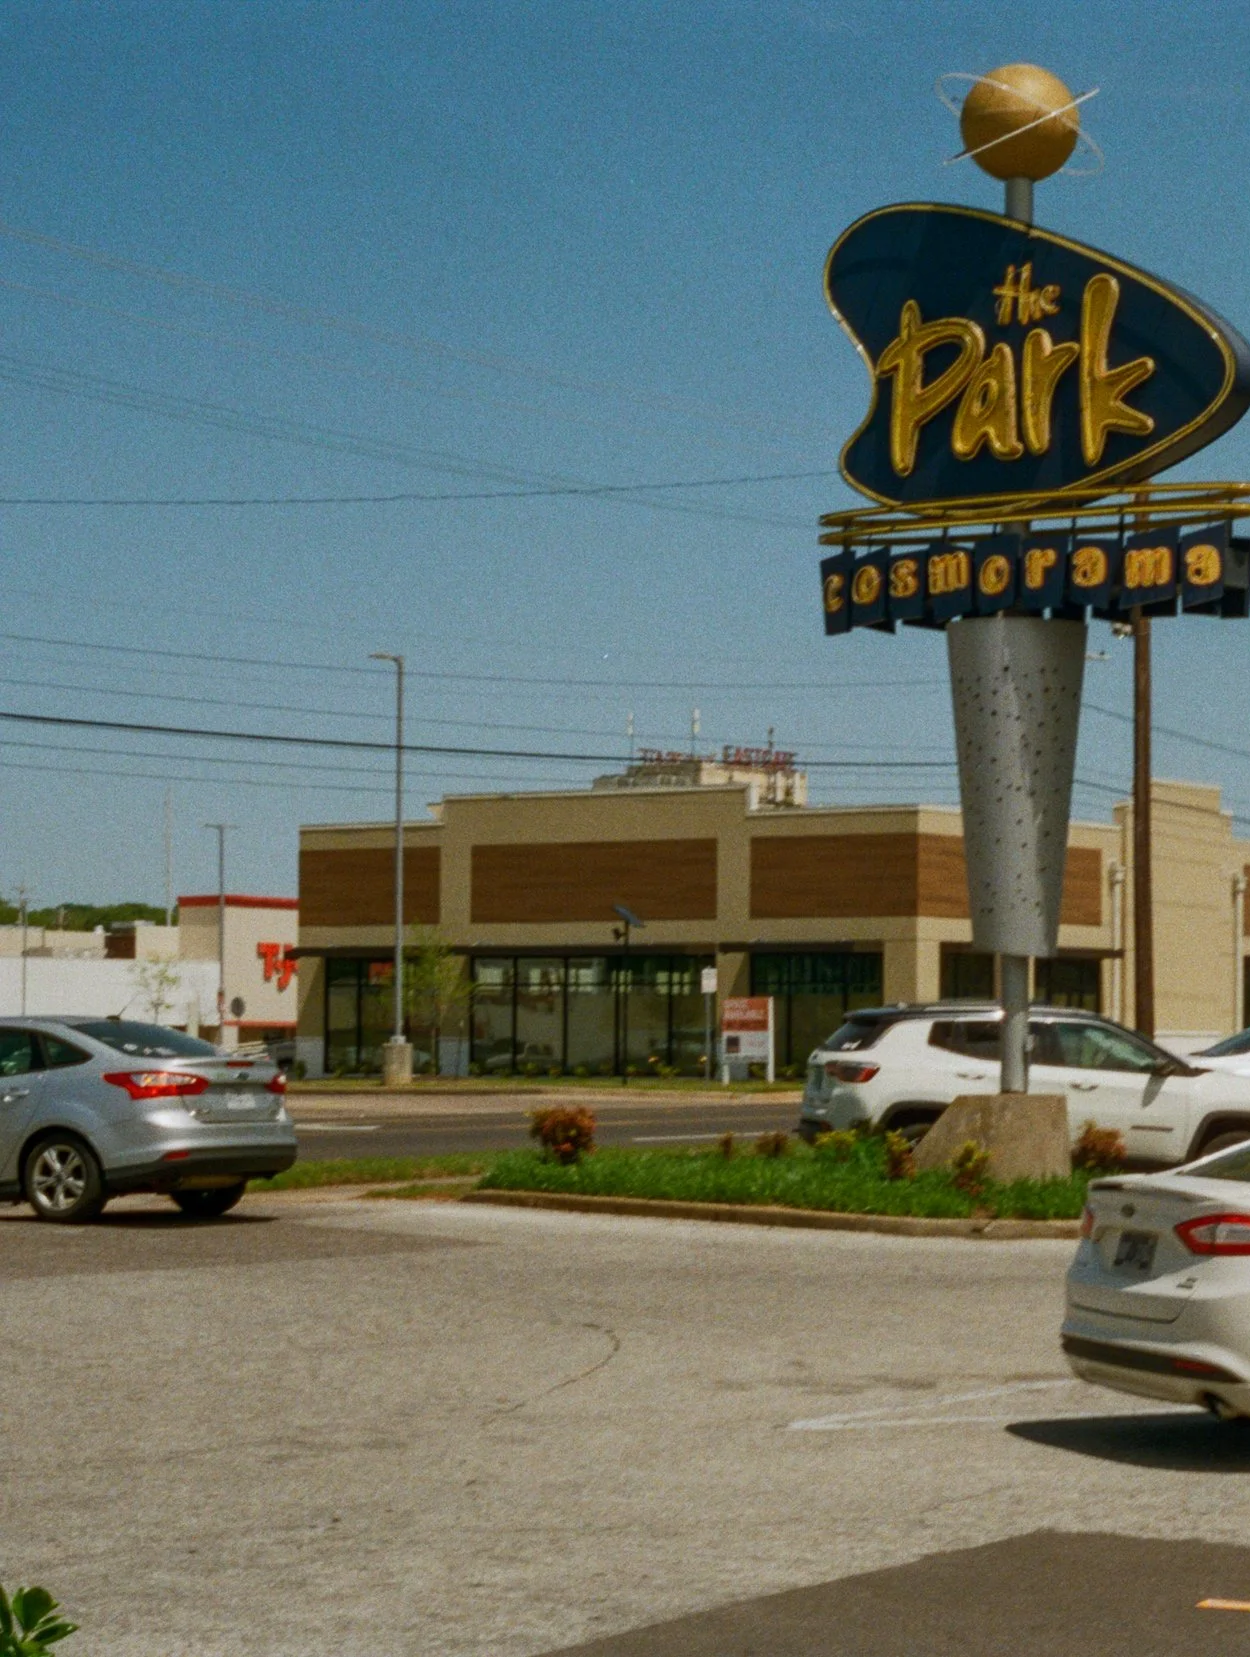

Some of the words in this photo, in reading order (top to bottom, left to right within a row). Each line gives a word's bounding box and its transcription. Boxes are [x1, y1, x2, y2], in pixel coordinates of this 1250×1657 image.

[993, 263, 1061, 325] the
[876, 272, 1156, 478] Park
[823, 543, 1223, 613] cosmorama
